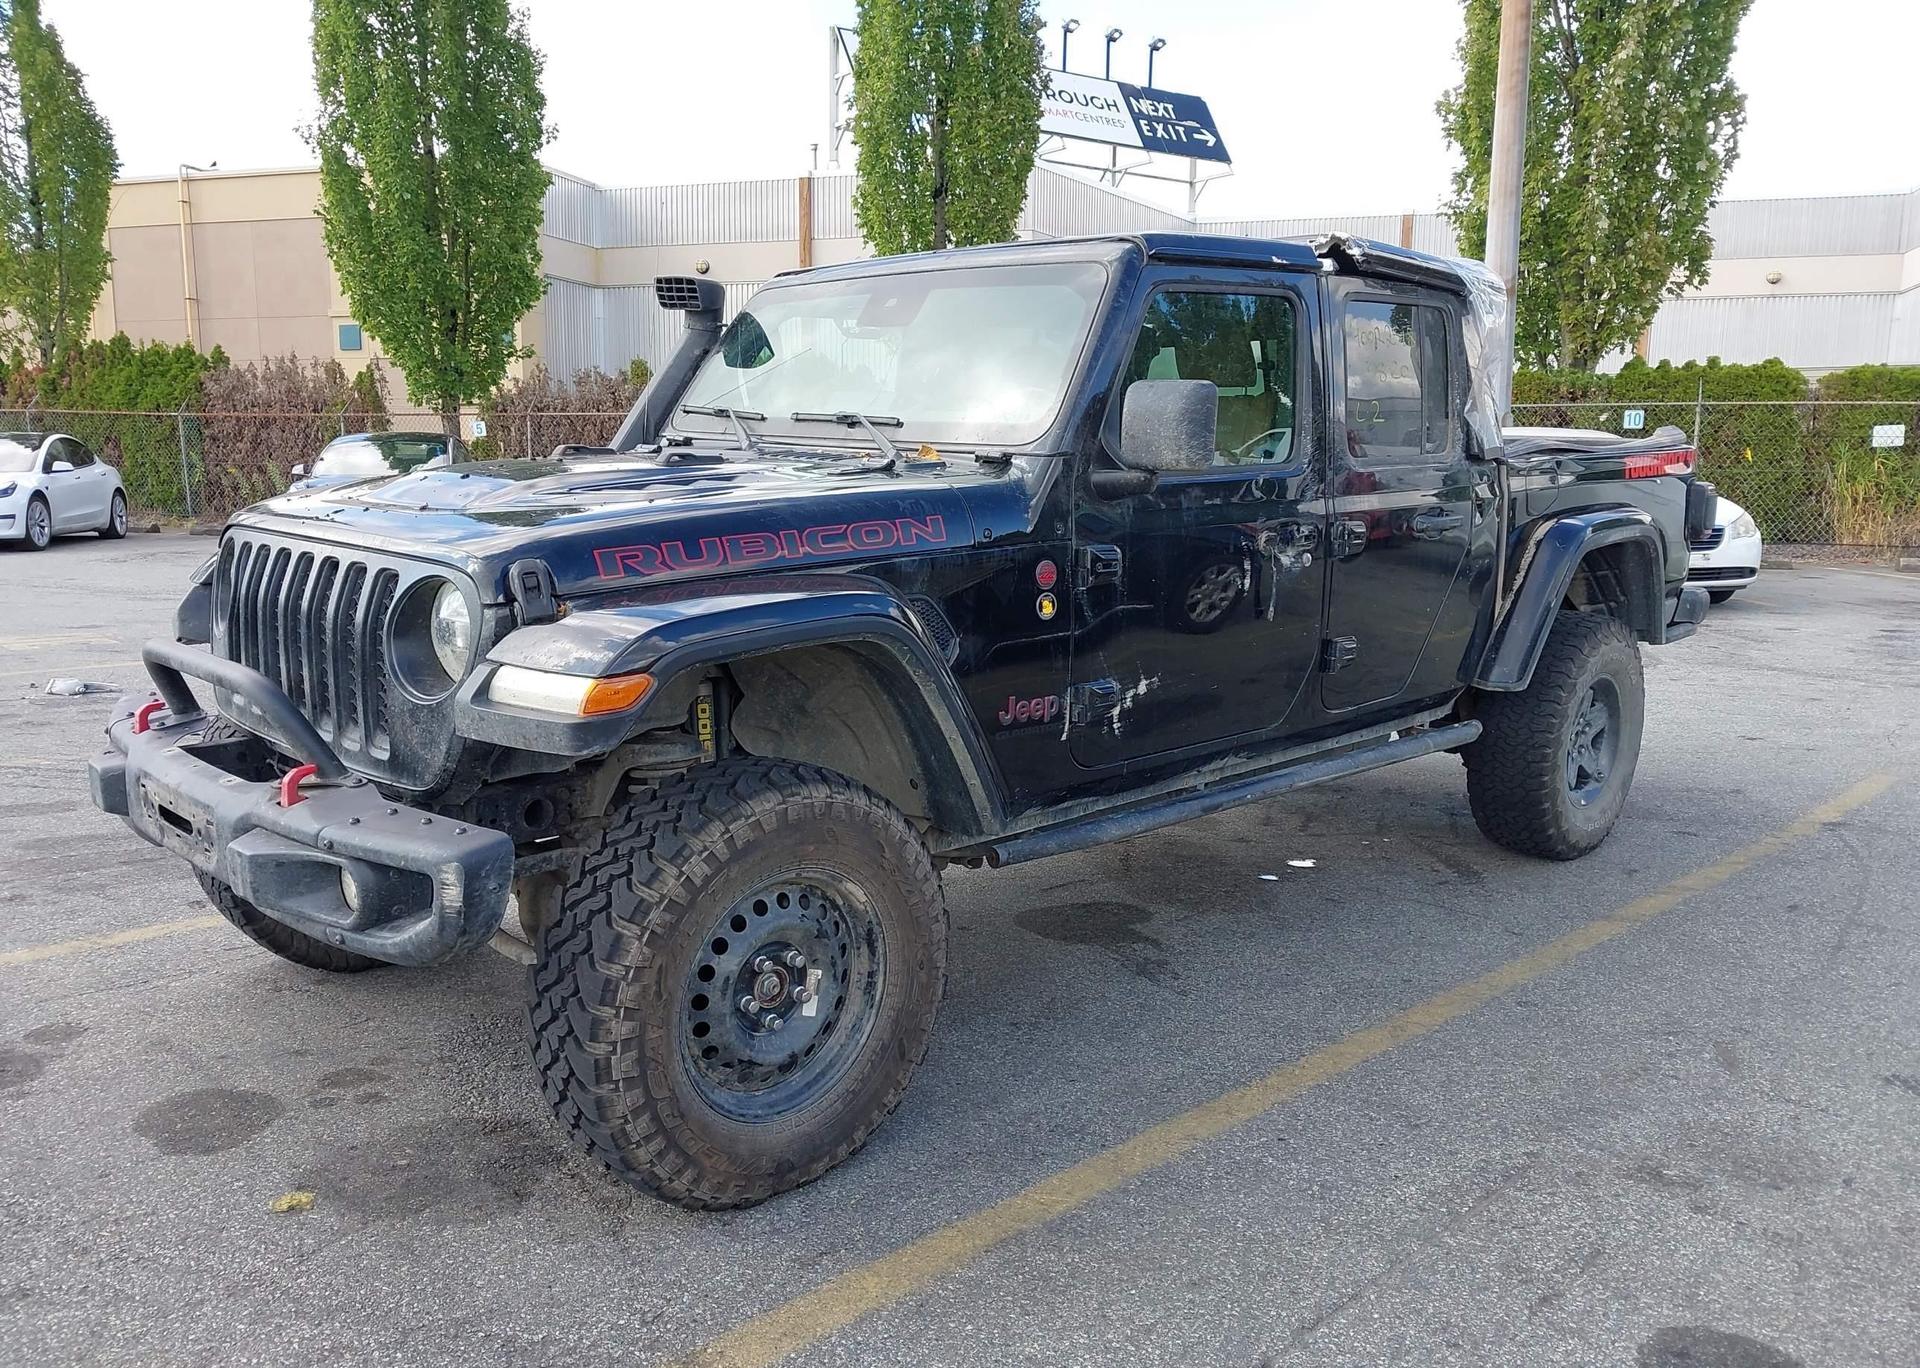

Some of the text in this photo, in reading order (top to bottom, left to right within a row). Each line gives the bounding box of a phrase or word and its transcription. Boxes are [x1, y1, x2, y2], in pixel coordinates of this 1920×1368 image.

[1043, 88, 1120, 113] ROUGH
[1128, 96, 1176, 120] NEXT
[1138, 119, 1188, 143] EXIT
[476, 424, 483, 435] 5
[1627, 412, 1641, 426] 10
[594, 515, 946, 579] RUBICON
[998, 694, 1059, 727] Jeep
